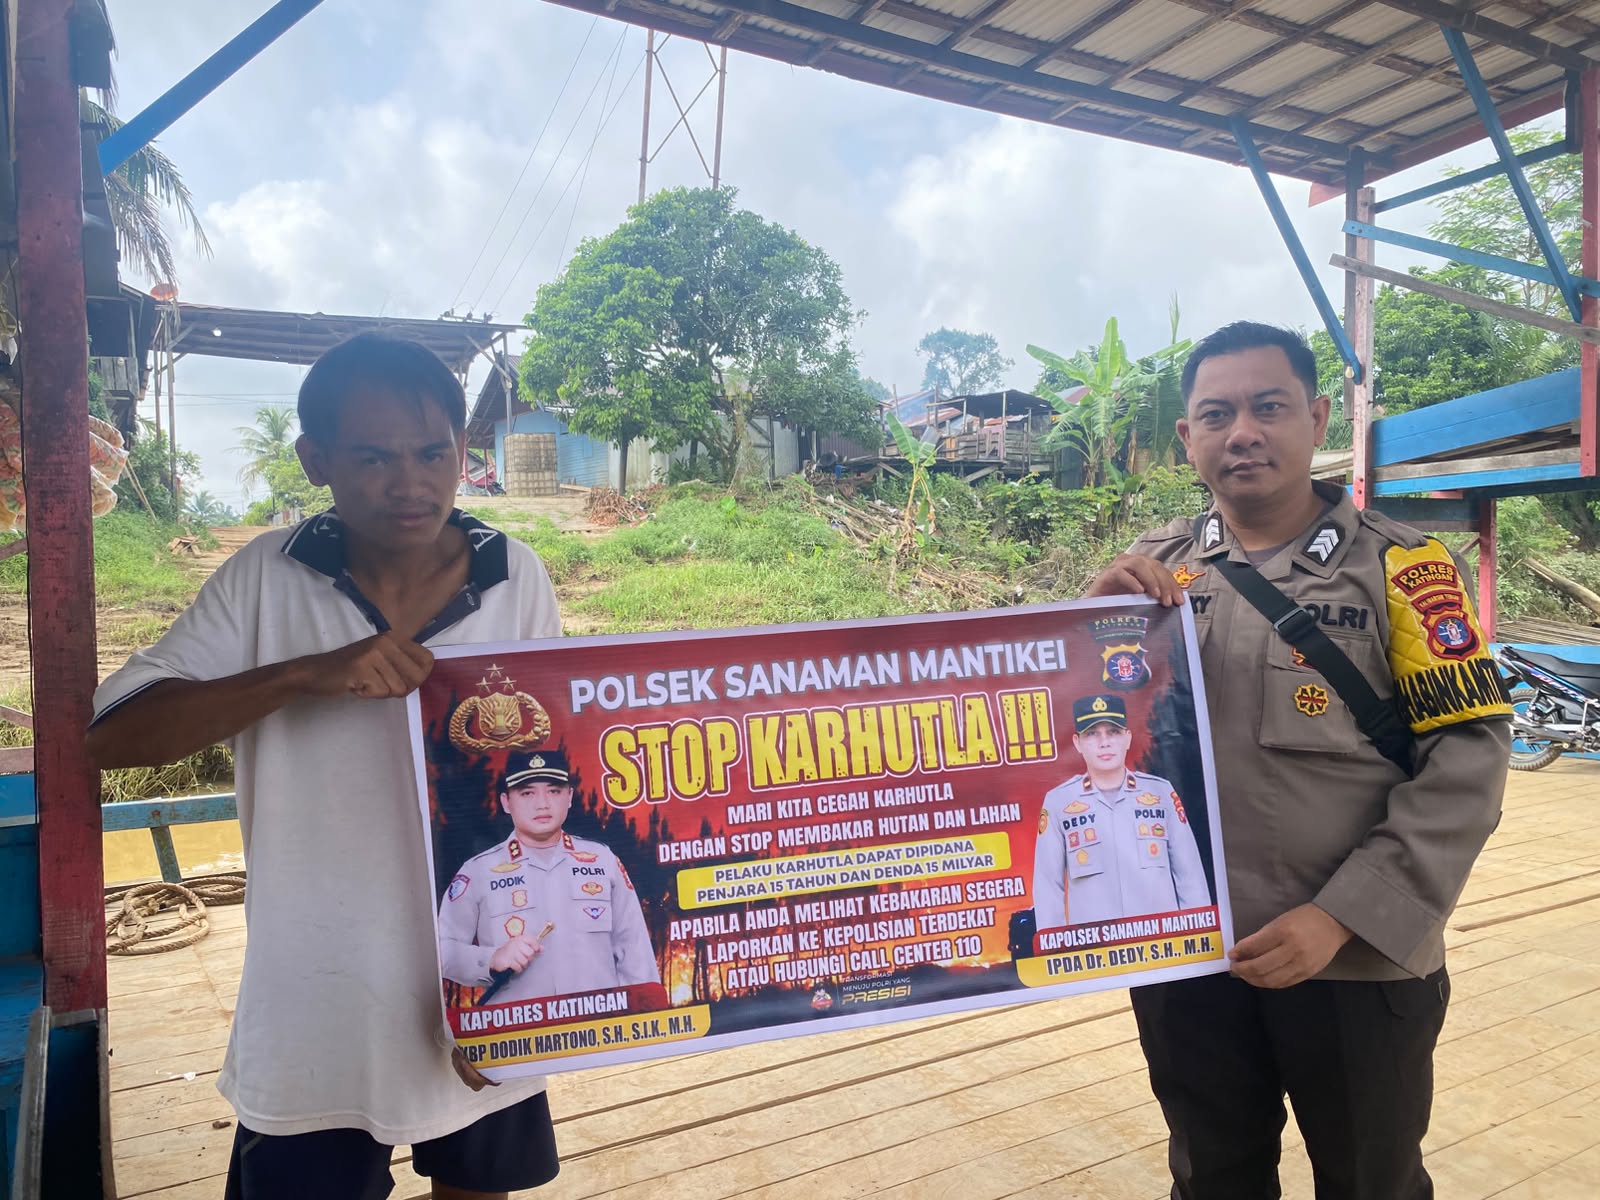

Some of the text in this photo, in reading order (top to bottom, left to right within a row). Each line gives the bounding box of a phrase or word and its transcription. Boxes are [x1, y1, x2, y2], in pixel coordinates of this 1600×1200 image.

[1399, 564, 1454, 585] POLRES
[1407, 573, 1454, 588] KATINGAN
[1303, 603, 1368, 629] OLRI
[571, 640, 1067, 713] POLSEK SANAMAN MANTIKEI
[603, 692, 1053, 805] STOP KARHUTLA !!!
[728, 783, 954, 825] MARI KITA CEGAH KARHUTLA
[1062, 814, 1096, 830] DEDY
[1134, 809, 1165, 819] POLRI
[659, 803, 1021, 863] DENGAN STOP MEMBAKAR HUTAN DAN LAHAN
[572, 866, 606, 876] POLRI
[697, 855, 994, 903] PENJARA 15 TAHUN DAN DENDA 15 MILYAR
[715, 840, 975, 883] PELAKU KARHUTLA DAPAT DIPIDANA
[490, 875, 526, 891] DODIK
[670, 877, 1025, 942] APABILA ANDA MELIHAT KEBAKARAN SEGERA
[707, 907, 996, 964] LAPORKAN KE KEPOLISIAN TERDEKAT
[1040, 910, 1216, 950] KAPOLSEK SANAMAN MANTIKEI
[728, 935, 981, 990] ATAU HUBUNGI CALL CENTER 110
[1047, 937, 1215, 976] IPDA Dr. DEDY, S.H., M.H.
[842, 985, 912, 1005] PRESISI
[843, 976, 911, 992] MENUJU POLRI YANG
[461, 991, 628, 1032] KAPOLRES KATINGAN
[460, 1015, 696, 1062] KBP DODIK HARTONO, S.H., S.I.K., M.H.
